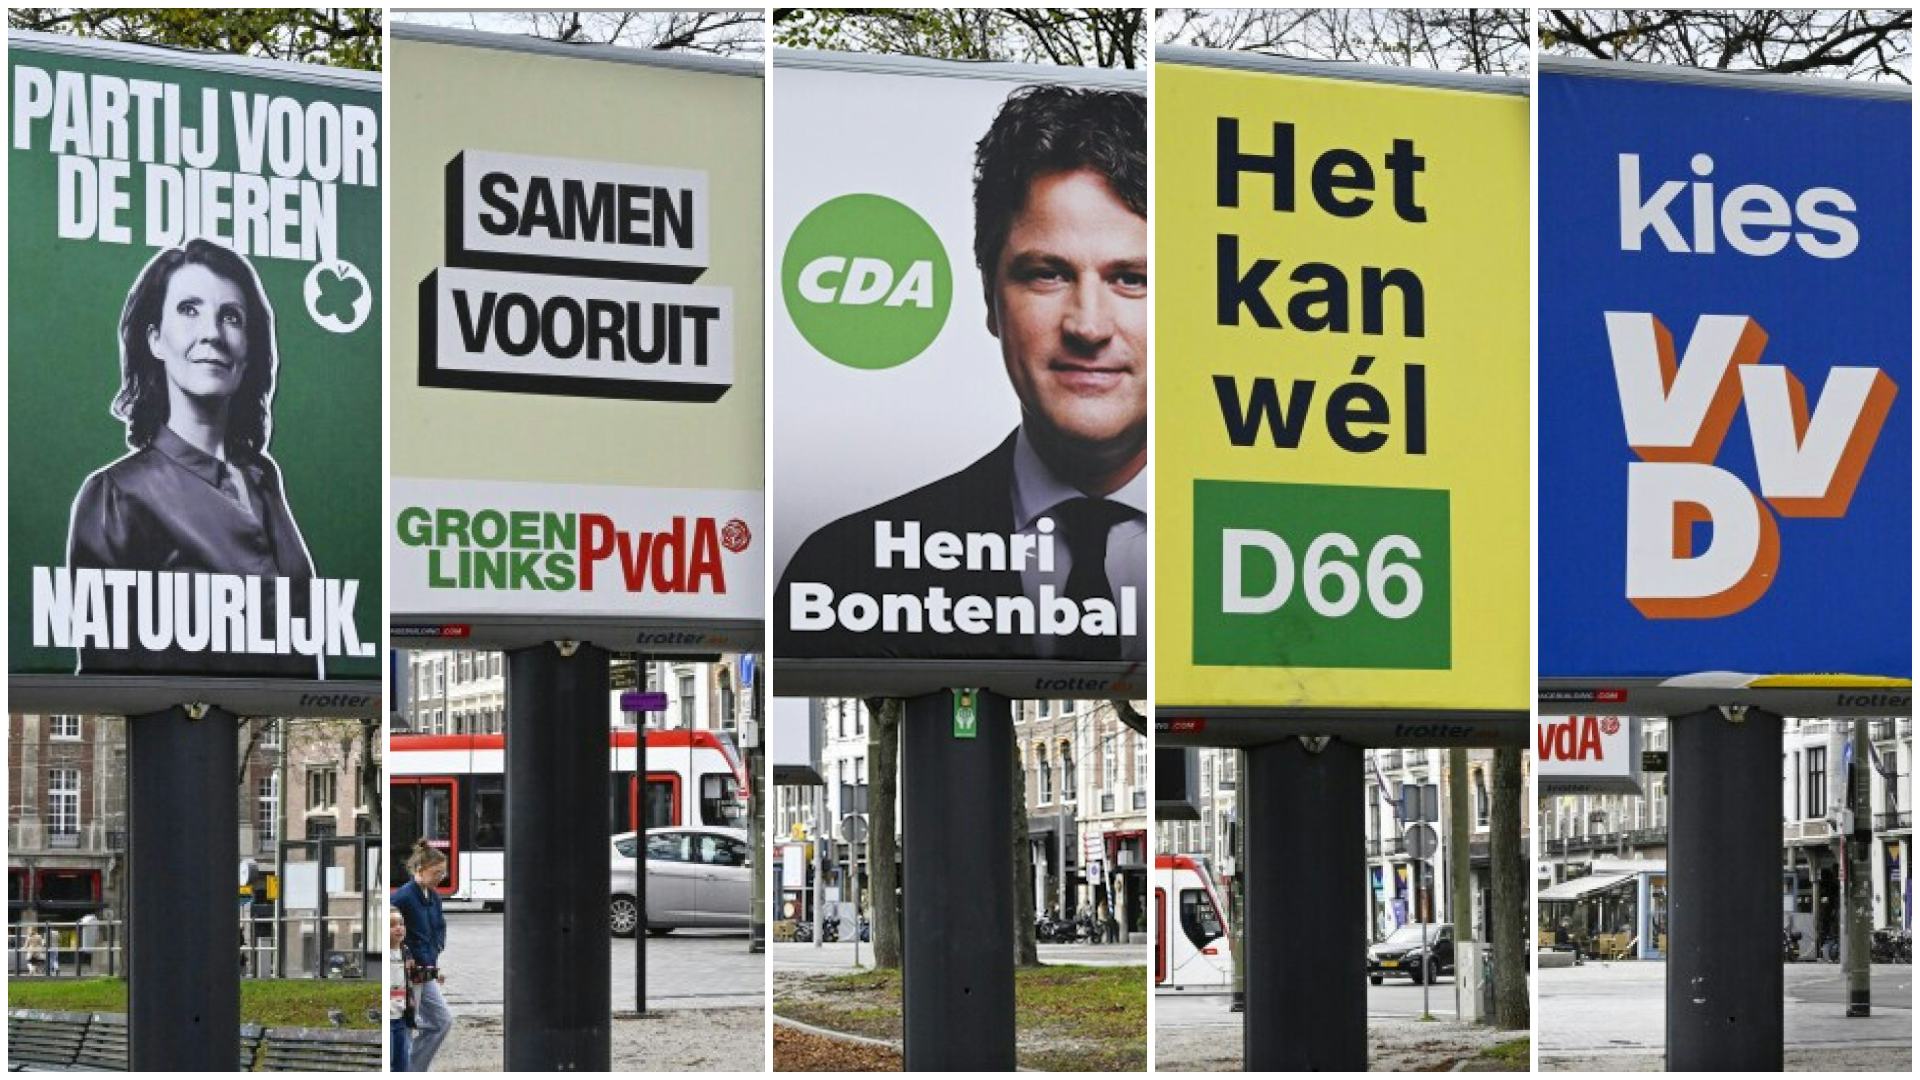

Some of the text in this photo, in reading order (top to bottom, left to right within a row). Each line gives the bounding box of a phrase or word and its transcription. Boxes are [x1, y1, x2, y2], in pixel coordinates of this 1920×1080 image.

[14, 64, 378, 187] PARTIJ VOOR
[58, 154, 337, 262] DE DIEREN
[478, 171, 693, 250] SAMEN
[1216, 116, 1427, 223] Het
[1618, 153, 1859, 259] kies
[798, 255, 934, 308] CDA
[1216, 233, 1425, 338] kan
[452, 289, 720, 367] VOORUIT
[1212, 356, 1427, 455] wél
[396, 506, 576, 550] GROEN
[429, 549, 576, 591] LINKS
[579, 513, 727, 594] PvdA
[874, 517, 1055, 572] Henri
[32, 565, 376, 657] NATUURLIJK.
[790, 582, 1137, 636] Bontenbal
[1222, 528, 1424, 619] D66
